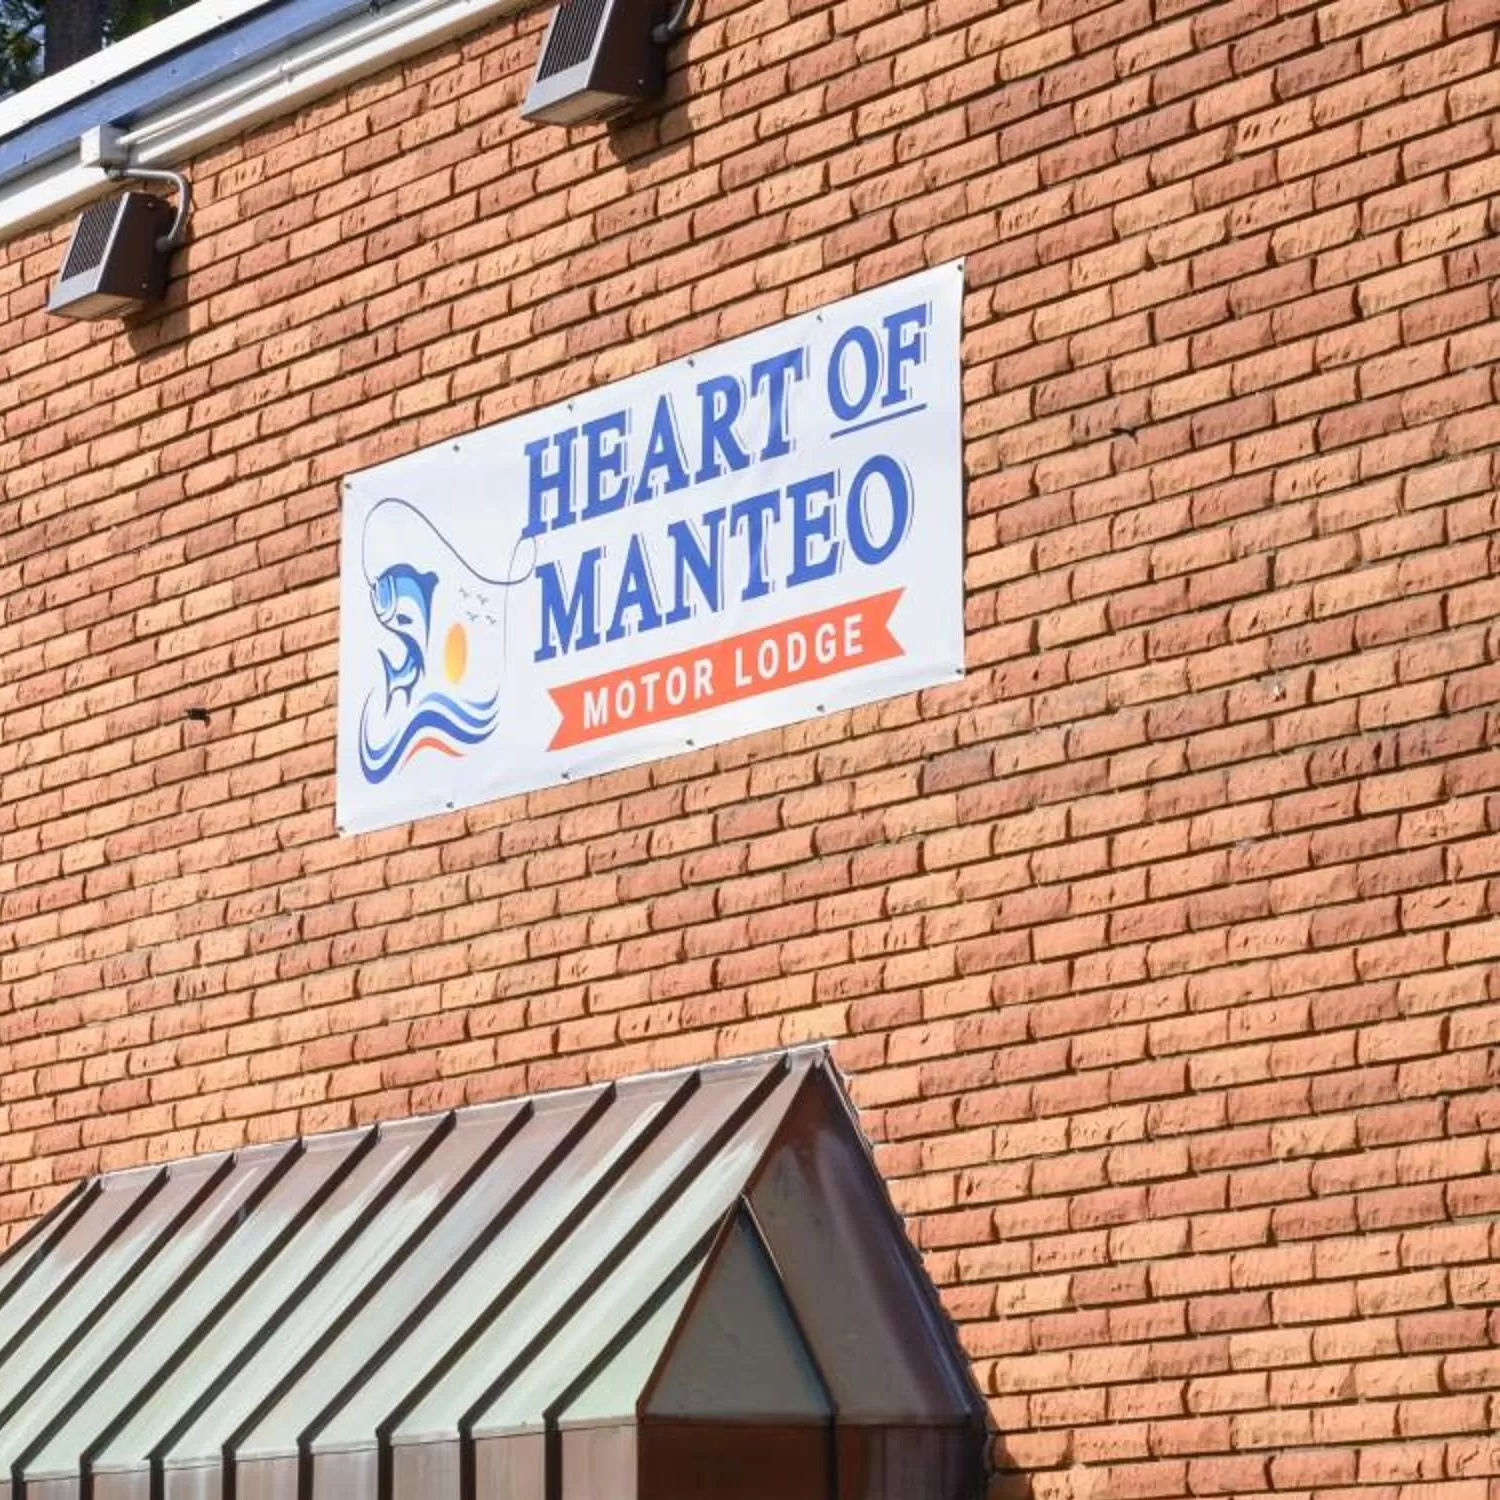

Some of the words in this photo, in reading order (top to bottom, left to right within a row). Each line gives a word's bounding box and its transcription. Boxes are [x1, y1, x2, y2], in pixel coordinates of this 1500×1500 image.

[520, 347, 811, 540] HEART
[826, 300, 933, 422] OF
[534, 453, 915, 663] MANTEO
[582, 659, 713, 731] MOTOR
[734, 613, 864, 690] LODGE
